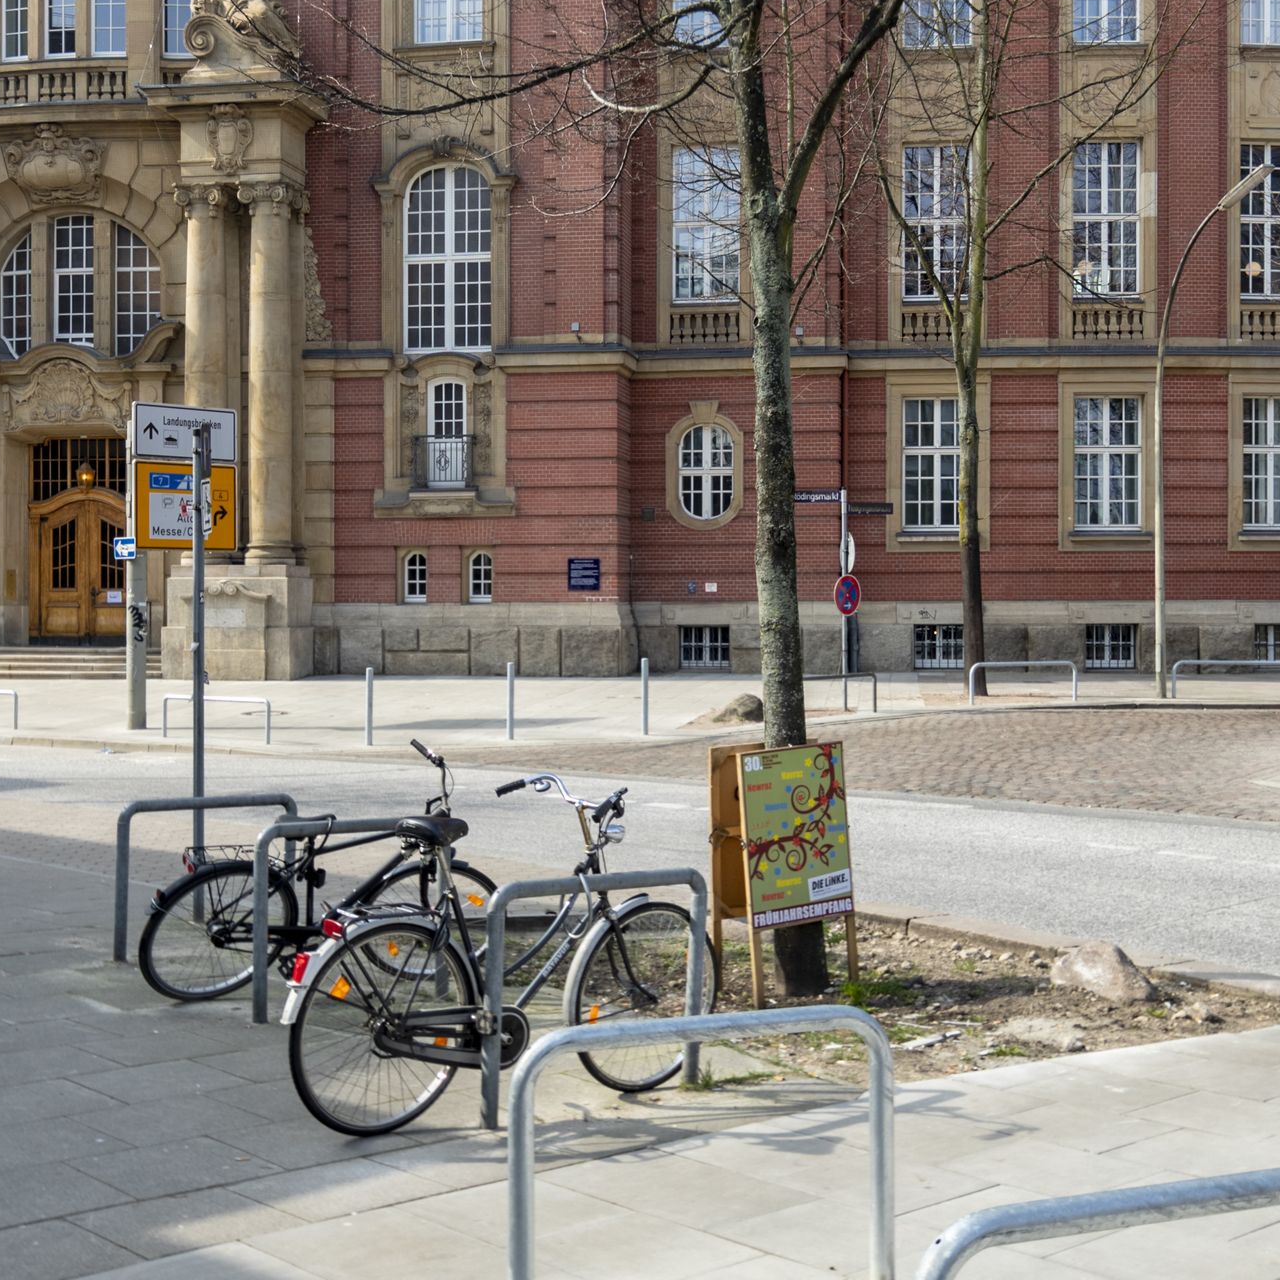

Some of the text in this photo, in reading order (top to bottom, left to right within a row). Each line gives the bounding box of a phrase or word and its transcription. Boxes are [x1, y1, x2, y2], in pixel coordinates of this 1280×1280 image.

[163, 416, 222, 430] Landungsbrken
[159, 477, 164, 485] 7
[794, 491, 839, 502] ödingsmarkt
[744, 756, 764, 772] 30.
[812, 880, 824, 891] DIE
[754, 898, 852, 928] FRÜHJAHRSEMPFANG
